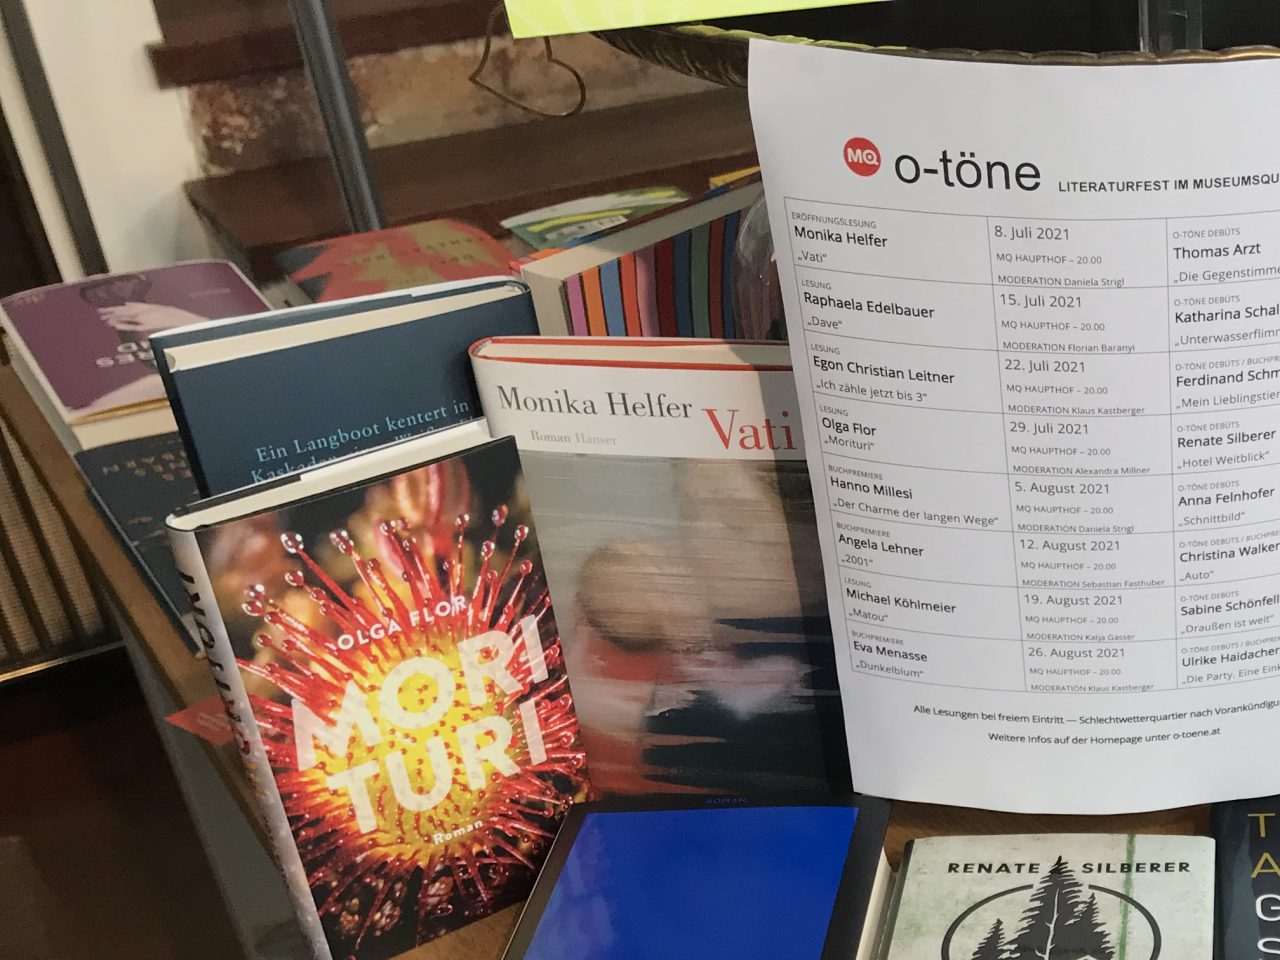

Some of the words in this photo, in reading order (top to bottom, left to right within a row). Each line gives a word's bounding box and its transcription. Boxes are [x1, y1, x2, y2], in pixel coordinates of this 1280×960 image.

[847, 148, 878, 165] MQ
[895, 150, 1040, 191] o-töne
[1058, 180, 1169, 193] LITERATURFEST
[1174, 178, 1188, 190] IM
[795, 226, 842, 243] Monika
[847, 233, 887, 248] Helfer
[994, 226, 1007, 238] 8.
[1011, 227, 1032, 240] Juli
[1037, 228, 1069, 240] 2021
[1173, 245, 1229, 259] Thomas
[1233, 243, 1261, 256] Arzt
[804, 292, 863, 312] Raphaela
[867, 301, 934, 318] Edelbauer
[1000, 294, 1021, 306] 15.
[1024, 295, 1045, 307] Juli
[1050, 296, 1082, 308] 2021
[1175, 309, 1241, 324] Katharina
[813, 356, 843, 372] Egon
[847, 361, 904, 379] Christian
[908, 369, 954, 384] Leitner
[1176, 371, 1244, 387] Ferdinand
[496, 385, 598, 415] Monika
[605, 391, 693, 419] Helfer
[701, 408, 797, 450] Vati
[822, 417, 849, 436] Olga
[852, 423, 876, 436] Flor
[256, 447, 288, 463] Ein
[294, 423, 380, 454] Langboot
[386, 406, 448, 432] kentert
[454, 400, 469, 414] in
[531, 430, 571, 444] Roman
[575, 433, 617, 445] Hanser
[1177, 435, 1223, 448] Renate
[1227, 429, 1276, 443] Silberer
[830, 476, 870, 493] Hanno
[874, 485, 912, 499] Millesi
[1178, 495, 1211, 507] Anna
[1216, 487, 1275, 504] Felnhofer
[838, 534, 878, 550] Angela
[882, 542, 924, 556] Lehner
[1180, 547, 1235, 563] Christina
[1239, 542, 1280, 556] Walker
[846, 588, 890, 606] Michael
[894, 596, 956, 614] Köhlmeier
[1181, 604, 1222, 616] Sabine
[336, 619, 403, 652] OLGA
[410, 594, 468, 626] FLOR
[854, 640, 872, 654] Eva
[876, 646, 928, 662] Menasse
[1182, 655, 1217, 667] Ulrike
[1220, 647, 1280, 664] Haidacher
[291, 614, 552, 771] MORI
[988, 733, 1026, 742] Weitere
[1028, 734, 1051, 744] Infos
[1054, 735, 1070, 744] auf
[1071, 735, 1087, 745] der
[1090, 734, 1142, 746] Homepage
[1145, 732, 1170, 743] unter
[1173, 727, 1220, 741] o-toene.at
[328, 700, 548, 835] TURI
[432, 818, 484, 847] Roman
[947, 863, 1041, 874] RENATE
[1081, 862, 1191, 874] SILBERER
